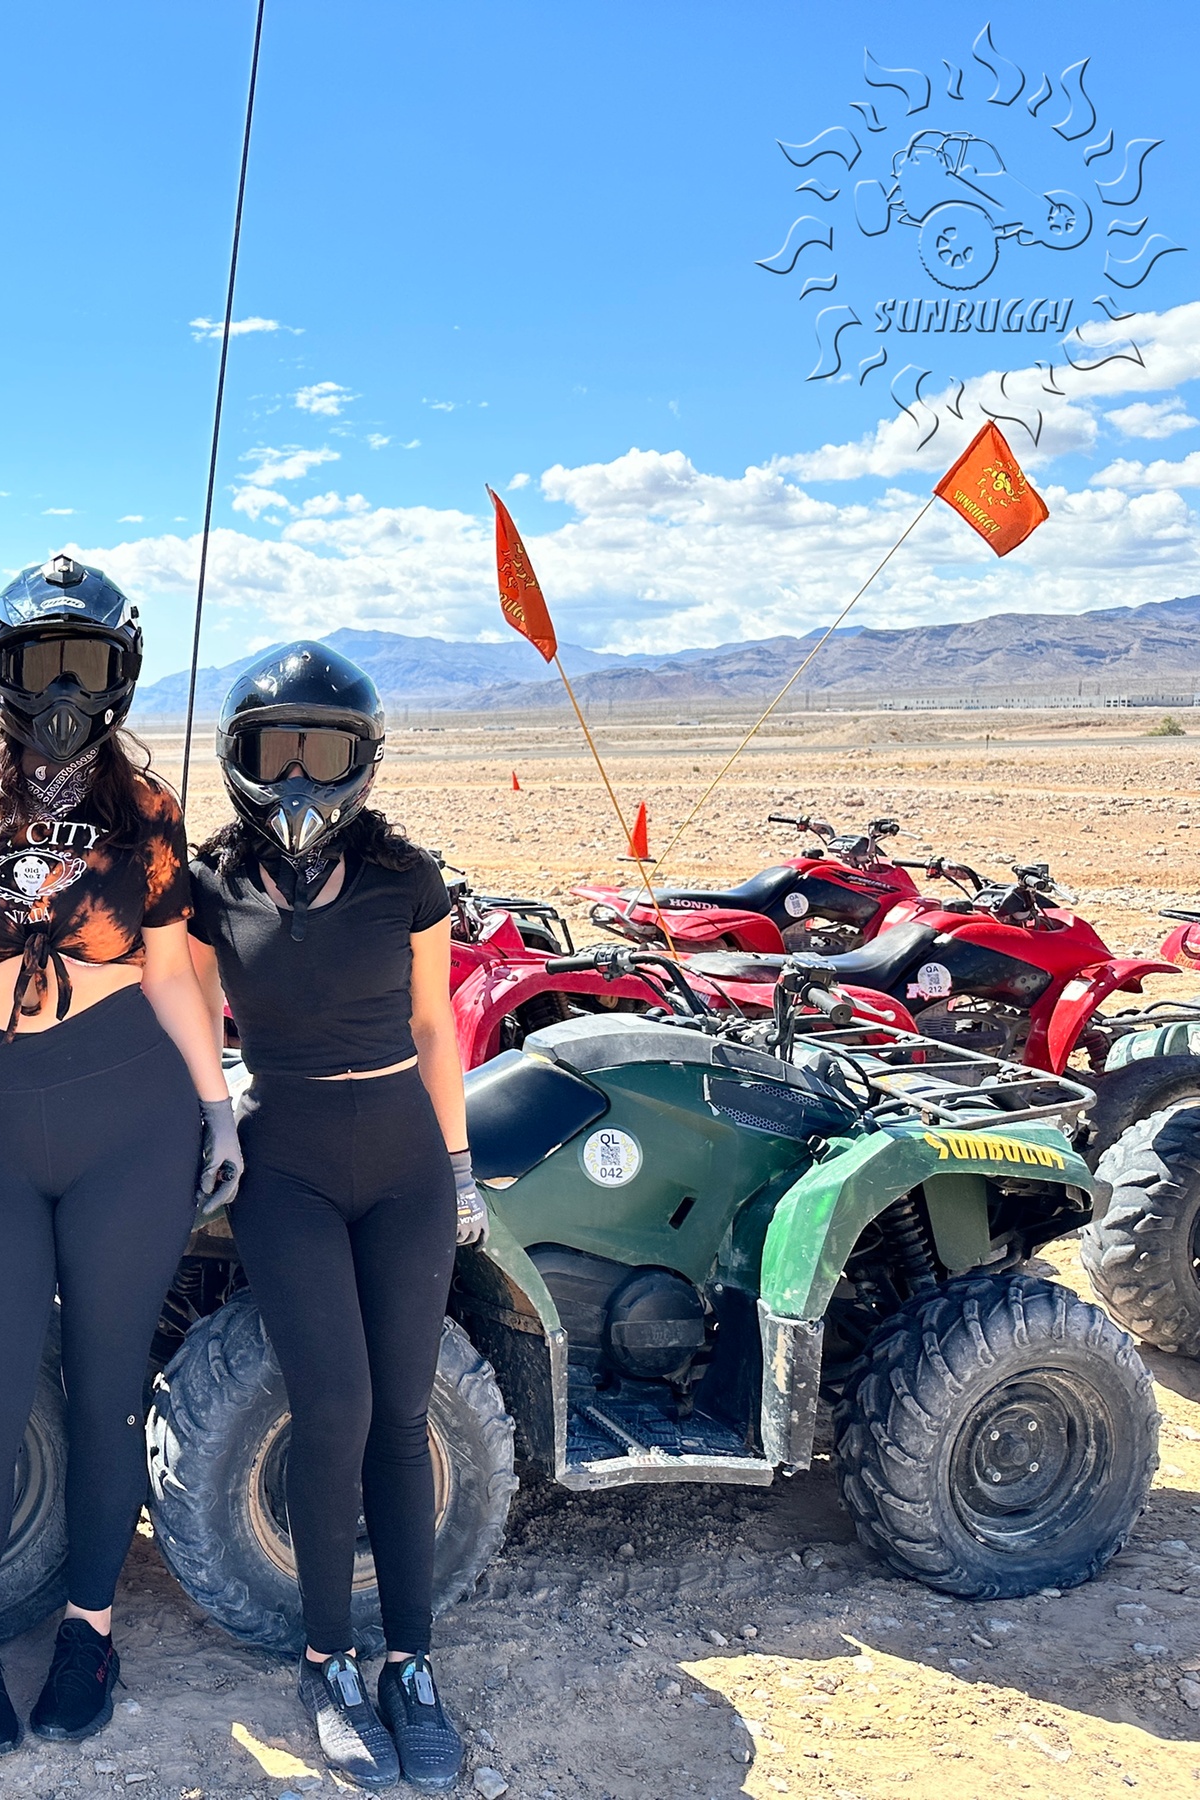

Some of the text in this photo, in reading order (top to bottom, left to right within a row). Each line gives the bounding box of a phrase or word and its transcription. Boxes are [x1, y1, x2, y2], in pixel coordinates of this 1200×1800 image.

[953, 489, 1001, 533] SUNBUGGY
[25, 821, 102, 850] CITY
[668, 898, 720, 910] HONDA
[928, 985, 943, 994] 212
[600, 1133, 620, 1148] QL
[600, 1167, 623, 1179] 042
